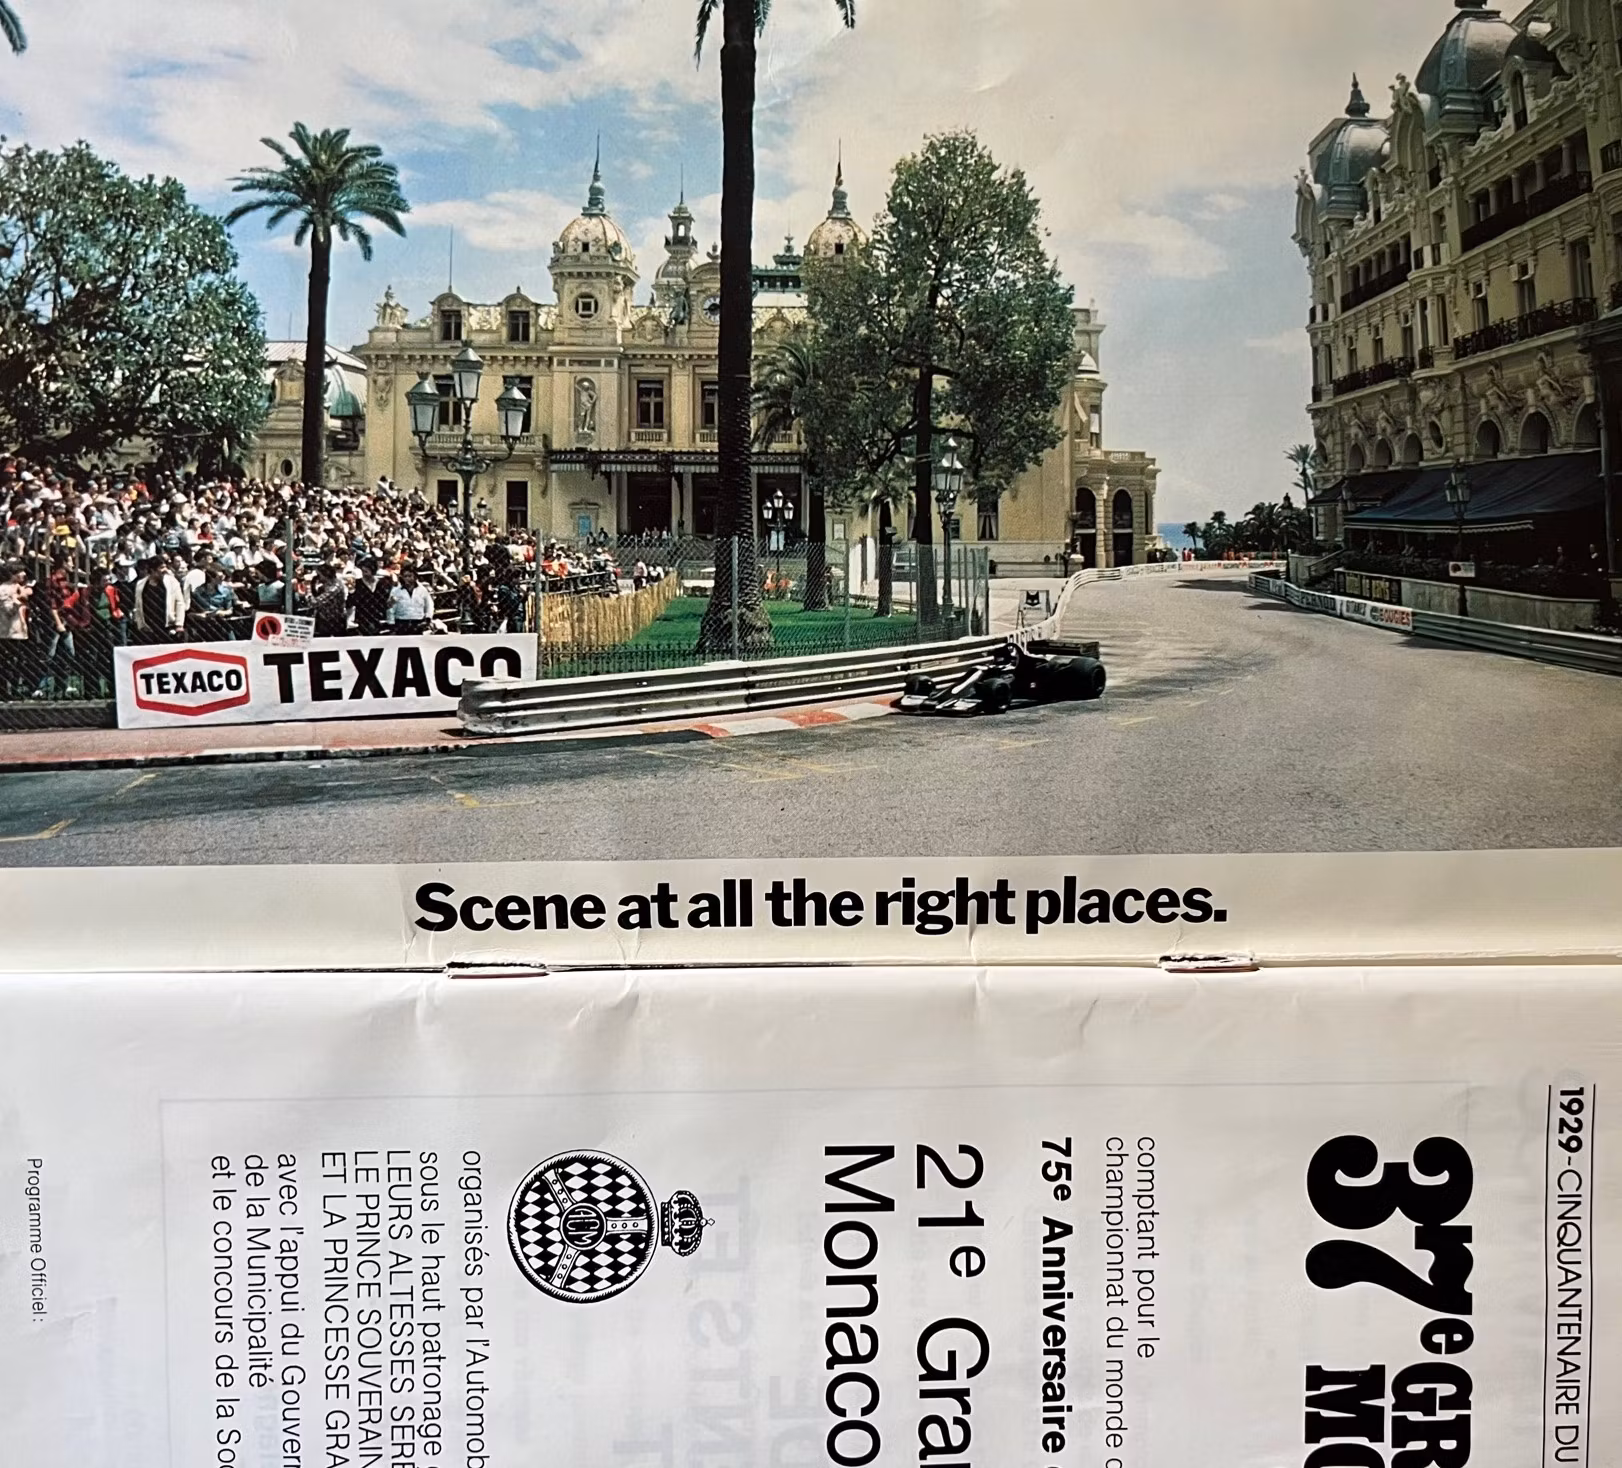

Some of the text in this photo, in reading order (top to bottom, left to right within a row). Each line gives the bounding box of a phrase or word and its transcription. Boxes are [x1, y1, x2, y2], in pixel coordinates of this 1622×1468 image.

[139, 668, 243, 695] TEXACO
[414, 875, 1228, 936] Scene at all the right places.
[24, 1158, 43, 1254] Programme
[210, 1155, 237, 1180] et
[212, 1189, 238, 1211] le
[277, 1153, 298, 1216] avec
[321, 1151, 347, 1185] ET
[322, 1194, 348, 1229] LA
[354, 1150, 380, 1184] LE
[386, 1150, 414, 1241] LEURS
[1041, 1136, 1073, 1202] 75e
[355, 1193, 382, 1299] PRINCE
[457, 1150, 490, 1277] organisés
[566, 1207, 601, 1246] ACM
[1100, 1136, 1130, 1307] championnat
[1131, 1136, 1161, 1359] comptant pour le
[1305, 1134, 1475, 1355] 37e
[213, 1220, 234, 1344] concours
[241, 1154, 275, 1388] de la Municipalité
[274, 1226, 306, 1312] l'appui
[416, 1151, 447, 1456] sous le haut patronage
[459, 1287, 484, 1330] par
[823, 1144, 896, 1468] Monaco
[916, 1143, 990, 1468] 21e Gra
[1554, 1086, 1585, 1463] 1929-CINQUANTENAIRE DU
[280, 1322, 305, 1356] du
[323, 1238, 350, 1401] PRINCESSE
[388, 1250, 415, 1394] ALTESSES
[1041, 1215, 1074, 1454] Anniversaire
[1105, 1316, 1129, 1349] du
[214, 1354, 240, 1388] de
[215, 1398, 241, 1420] la
[1105, 1359, 1129, 1449] monde
